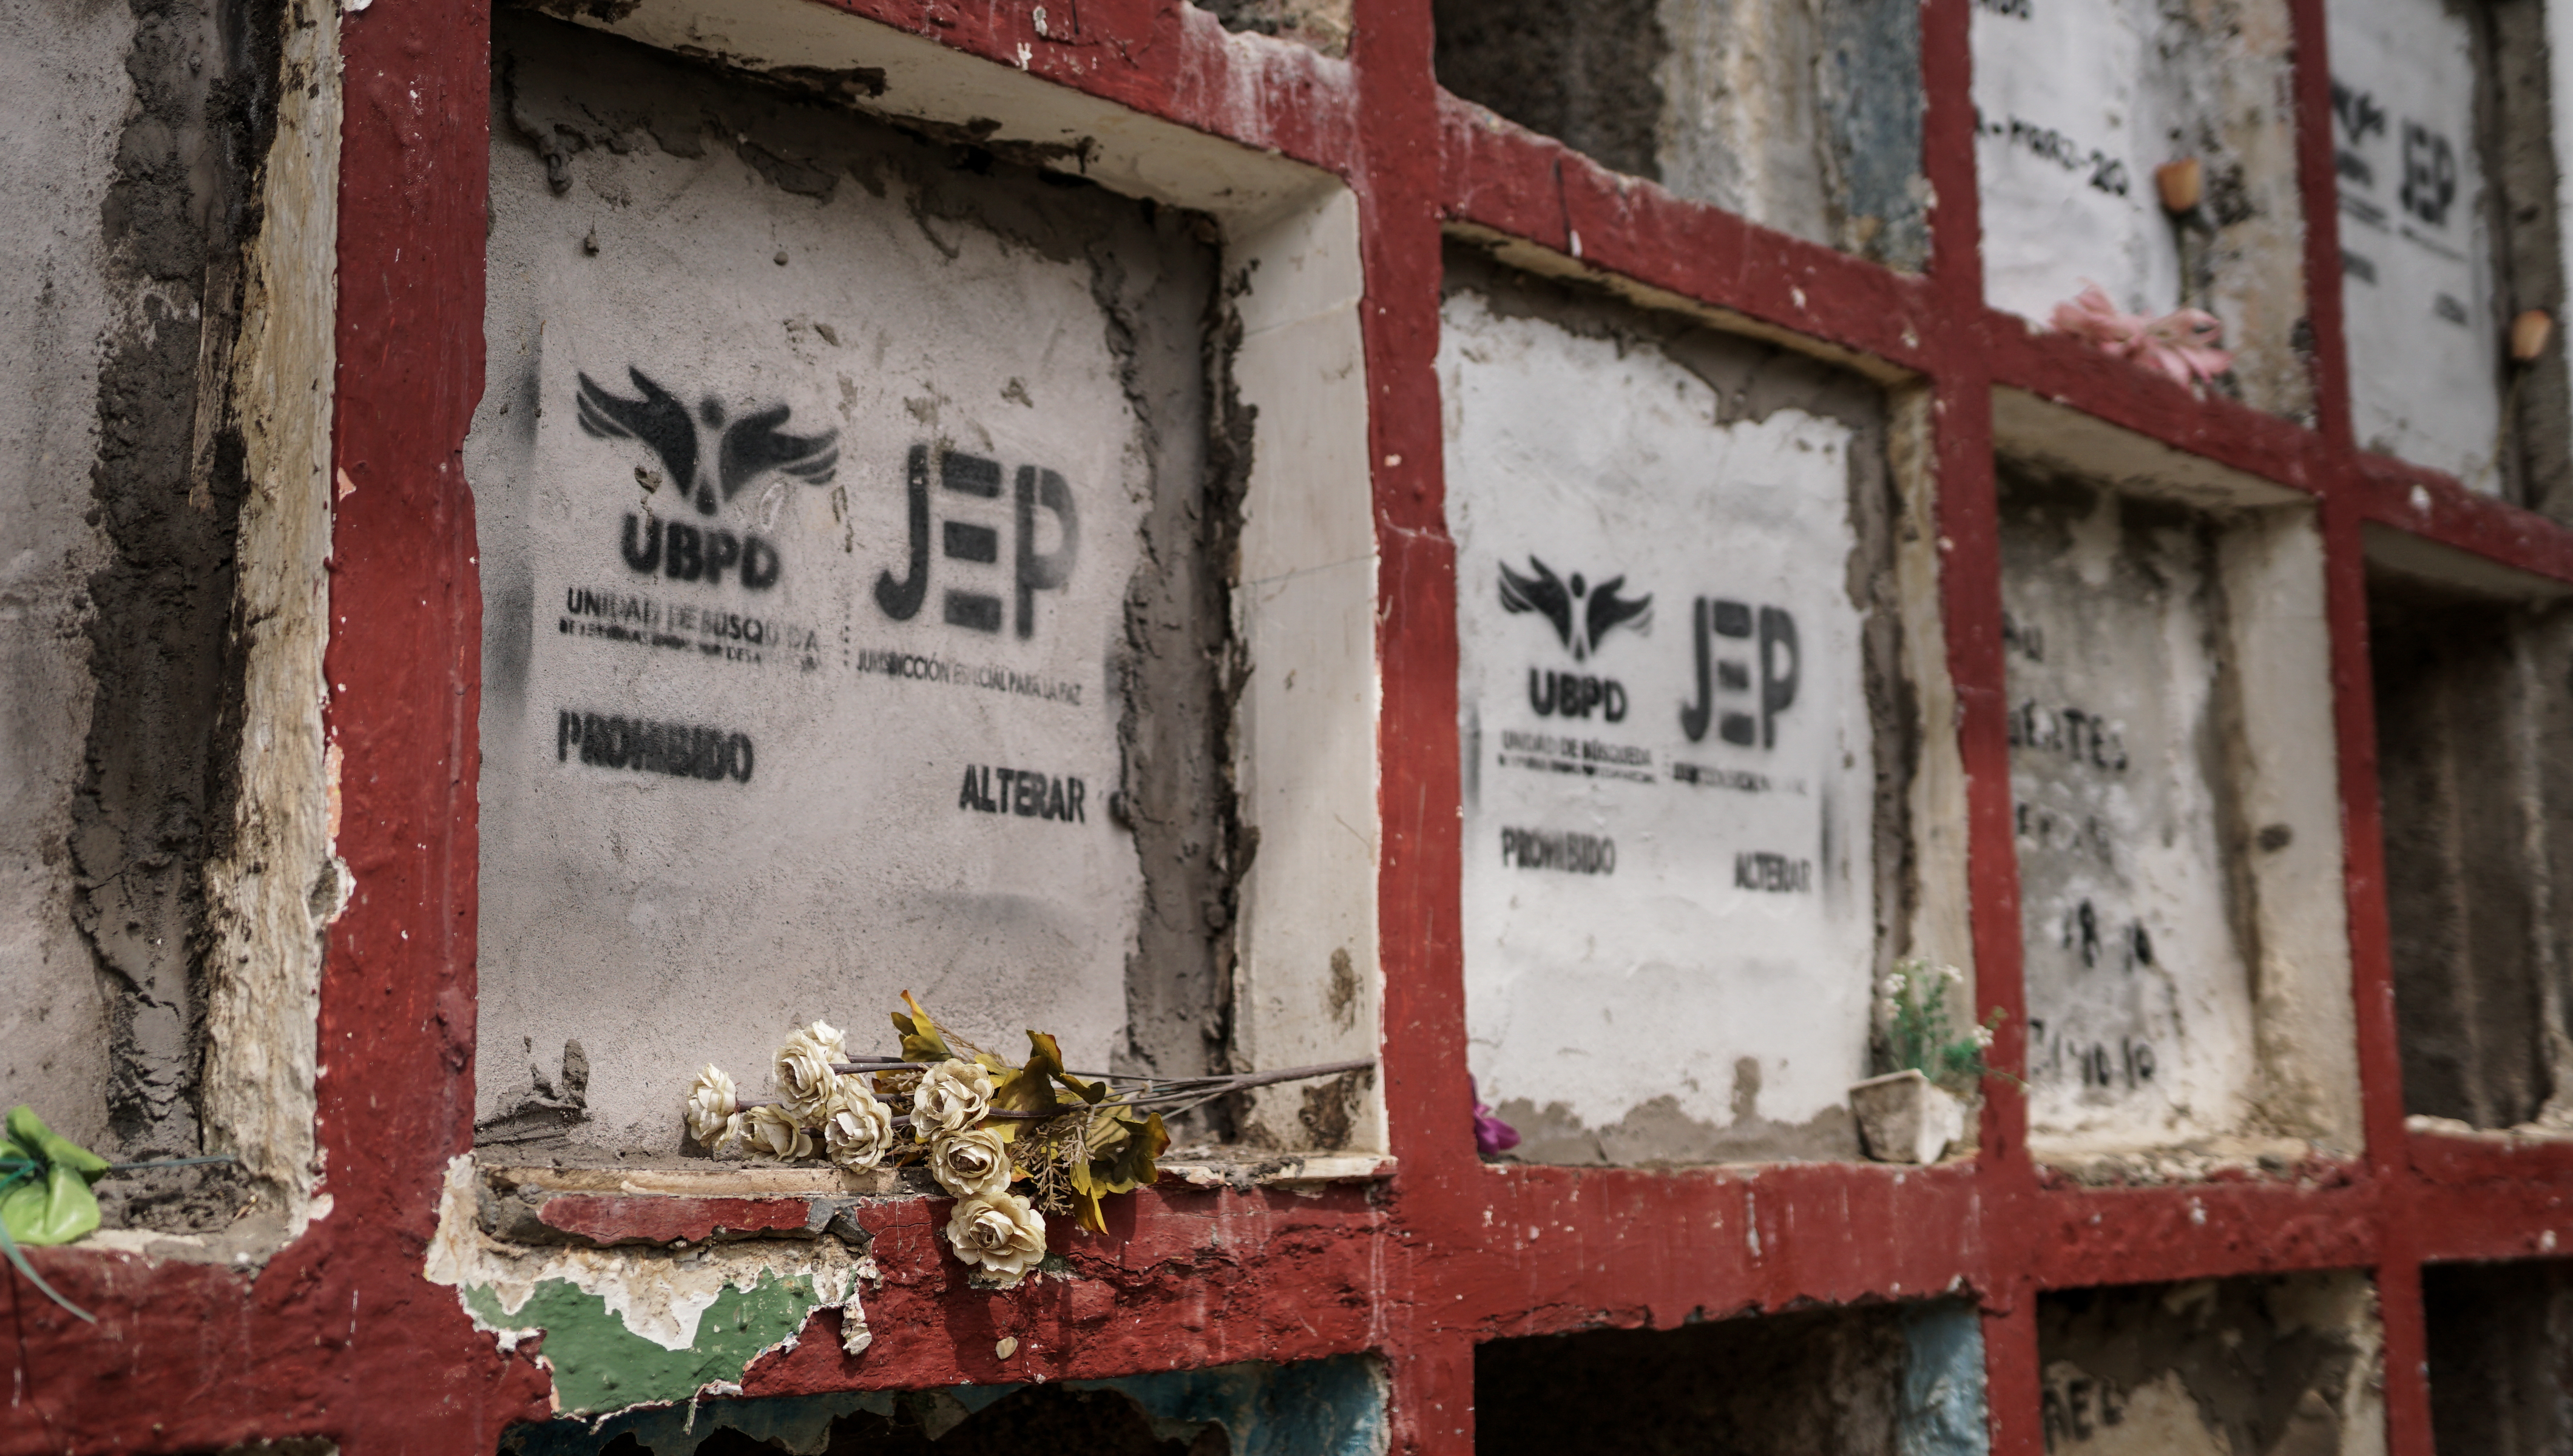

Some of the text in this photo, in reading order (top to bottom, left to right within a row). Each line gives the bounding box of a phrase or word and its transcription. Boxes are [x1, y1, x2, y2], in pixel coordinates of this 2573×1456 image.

[621, 513, 780, 590] UBPD
[874, 443, 1080, 641] JEP
[1529, 666, 1628, 724] UBPD
[1680, 595, 1801, 751] JEP
[958, 763, 1085, 824] ALTERAR
